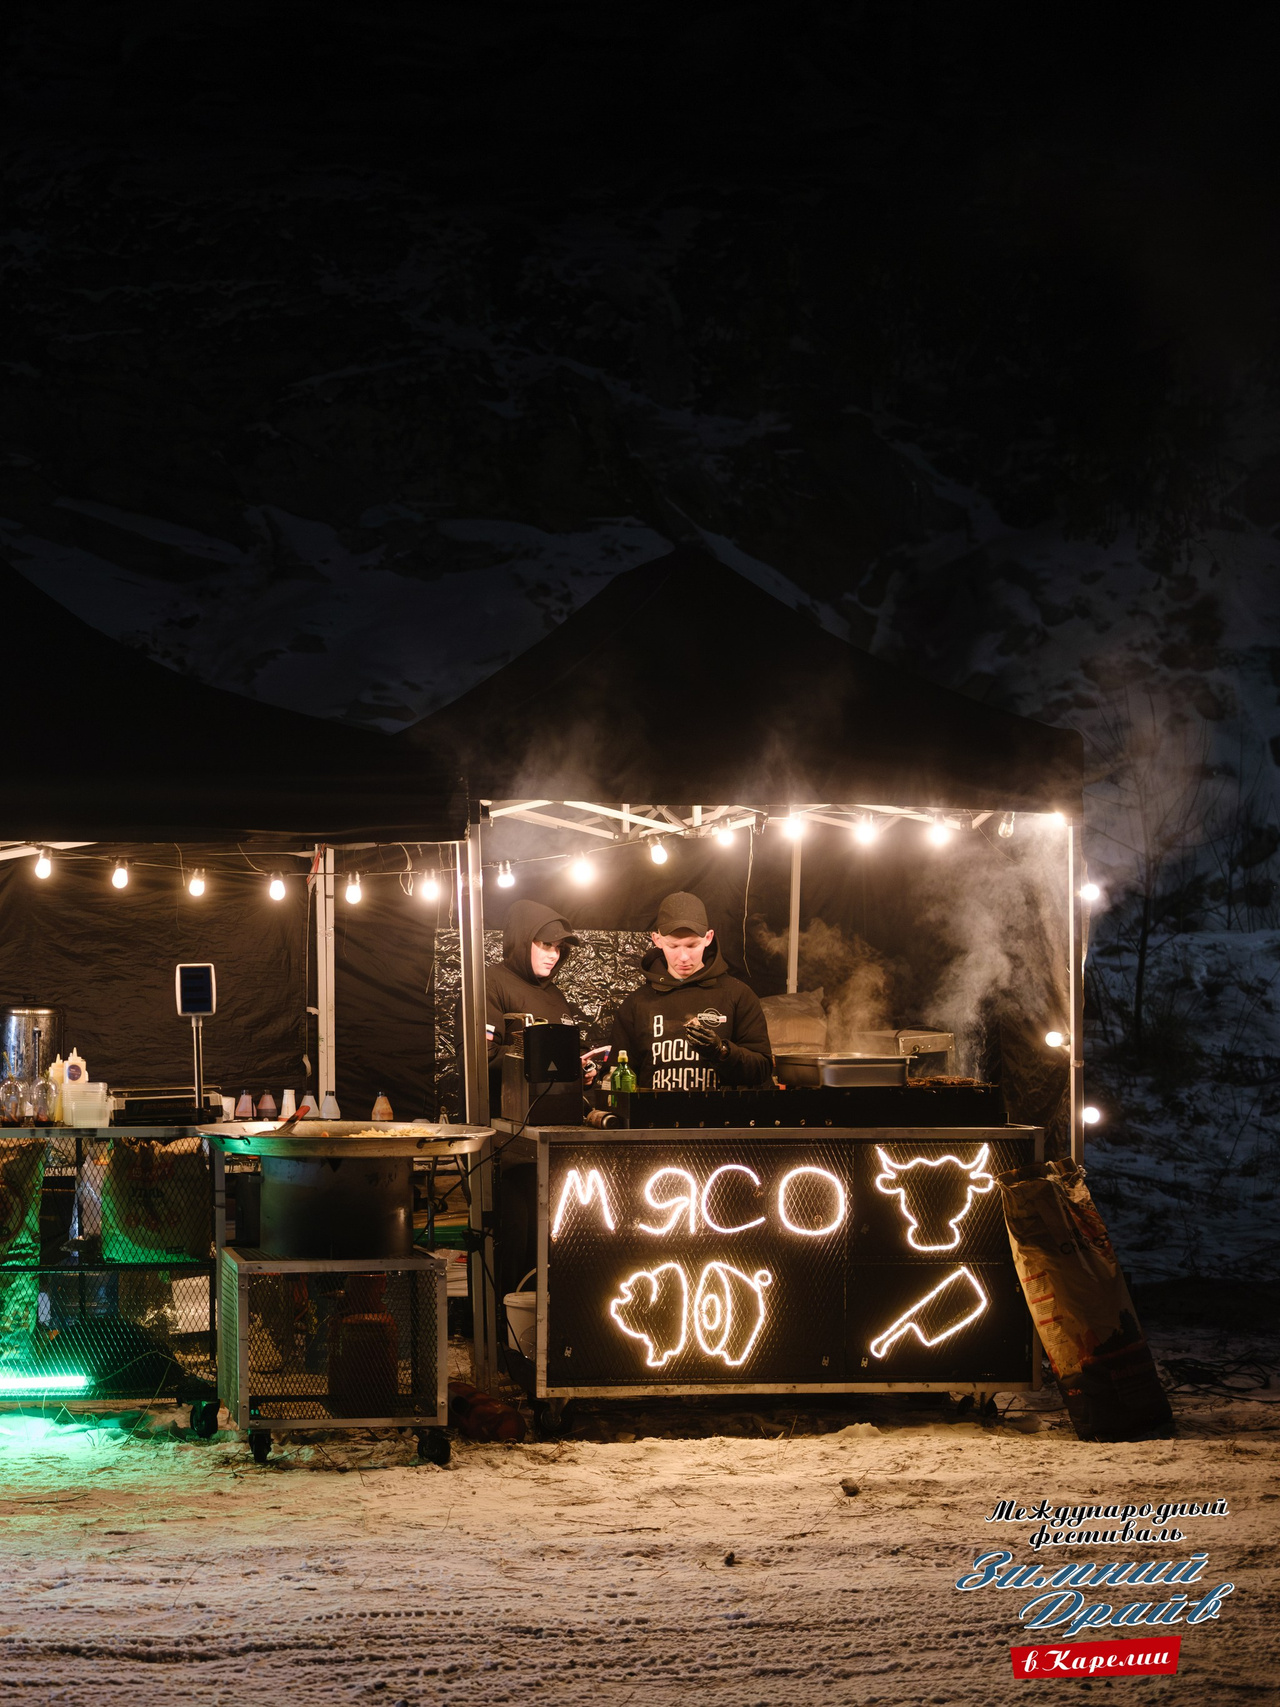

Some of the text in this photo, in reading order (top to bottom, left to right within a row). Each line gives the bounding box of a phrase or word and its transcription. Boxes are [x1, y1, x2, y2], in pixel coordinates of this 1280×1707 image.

[653, 1014, 664, 1038] В
[651, 1038, 700, 1066] РОСС
[551, 1163, 848, 1237] МЯСО
